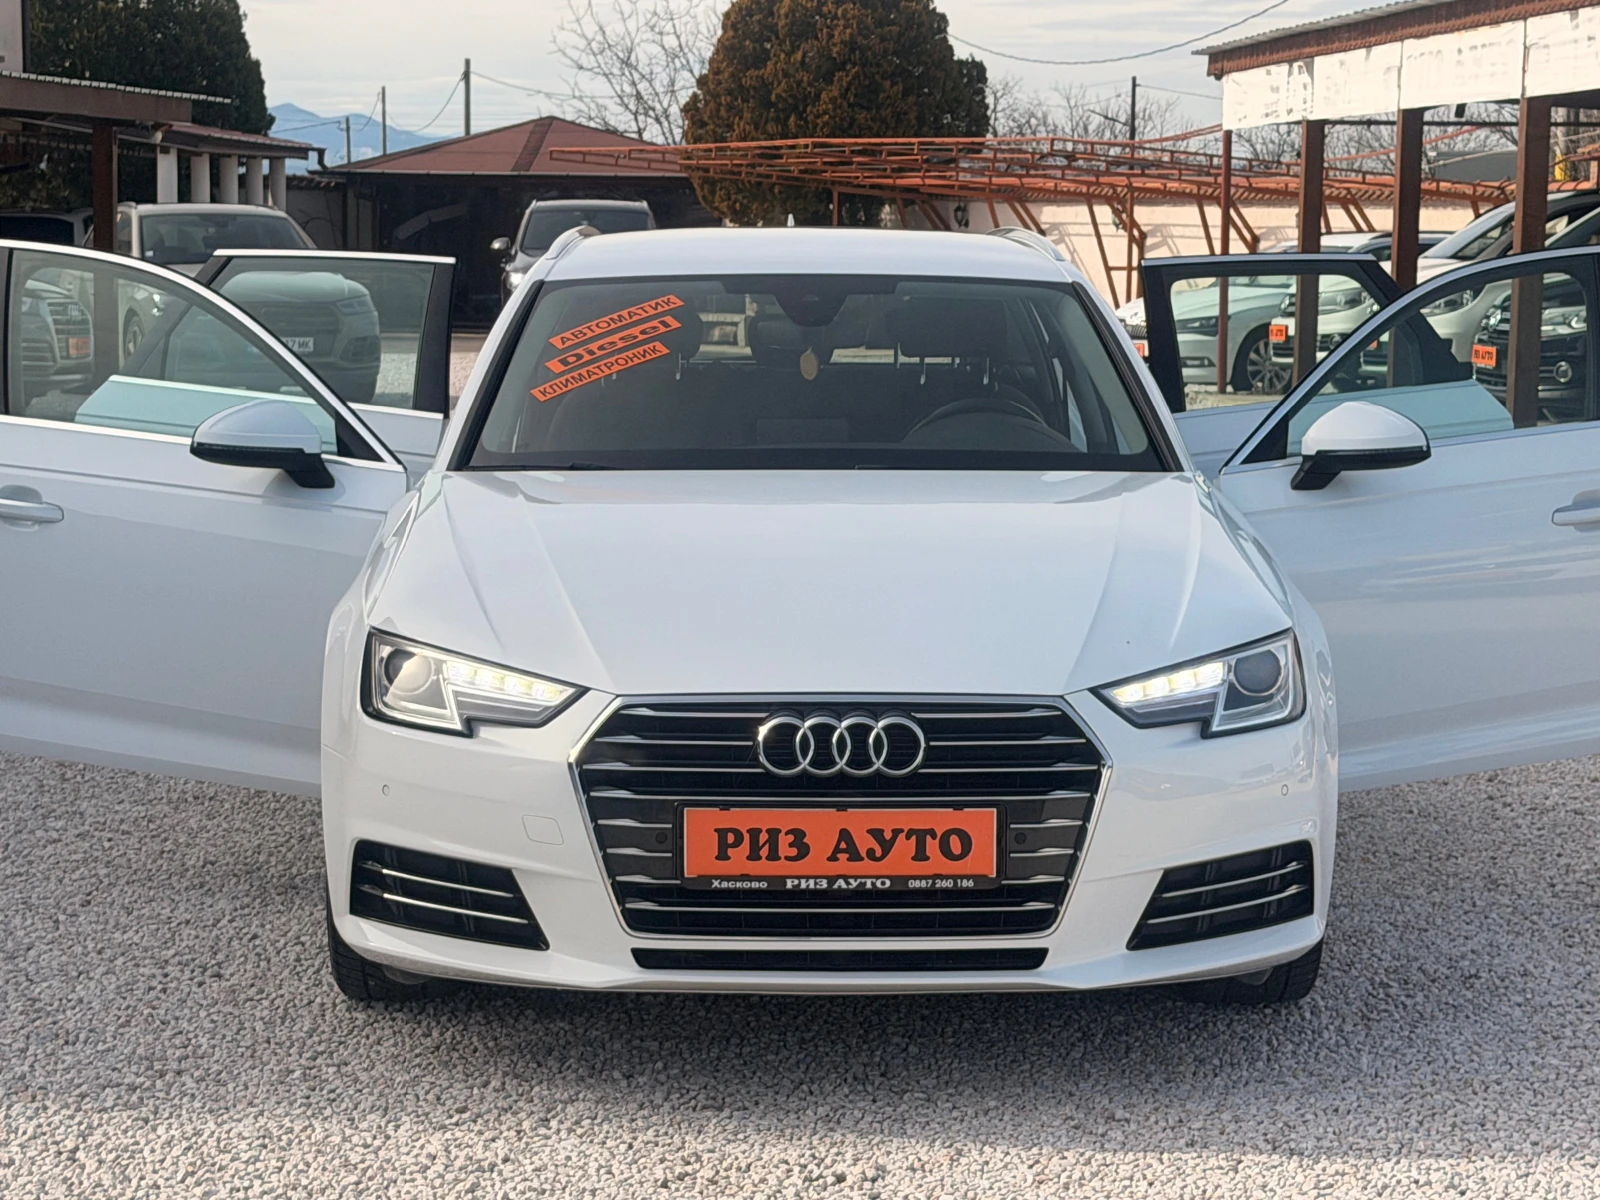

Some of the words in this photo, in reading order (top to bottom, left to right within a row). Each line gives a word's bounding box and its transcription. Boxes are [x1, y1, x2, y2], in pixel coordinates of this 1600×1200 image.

[556, 319, 672, 368] Diesel
[559, 297, 678, 346] АВТОМАТИК
[537, 344, 662, 398] КЛИМАТРОНИК
[713, 827, 811, 862] РИЗ
[826, 828, 973, 862] АУТО
[711, 879, 768, 888] Хасково
[785, 878, 828, 889] РИЗ
[832, 878, 891, 889] АУТО
[908, 879, 932, 888] 0887
[935, 879, 954, 888] 260
[956, 879, 975, 888] 186
